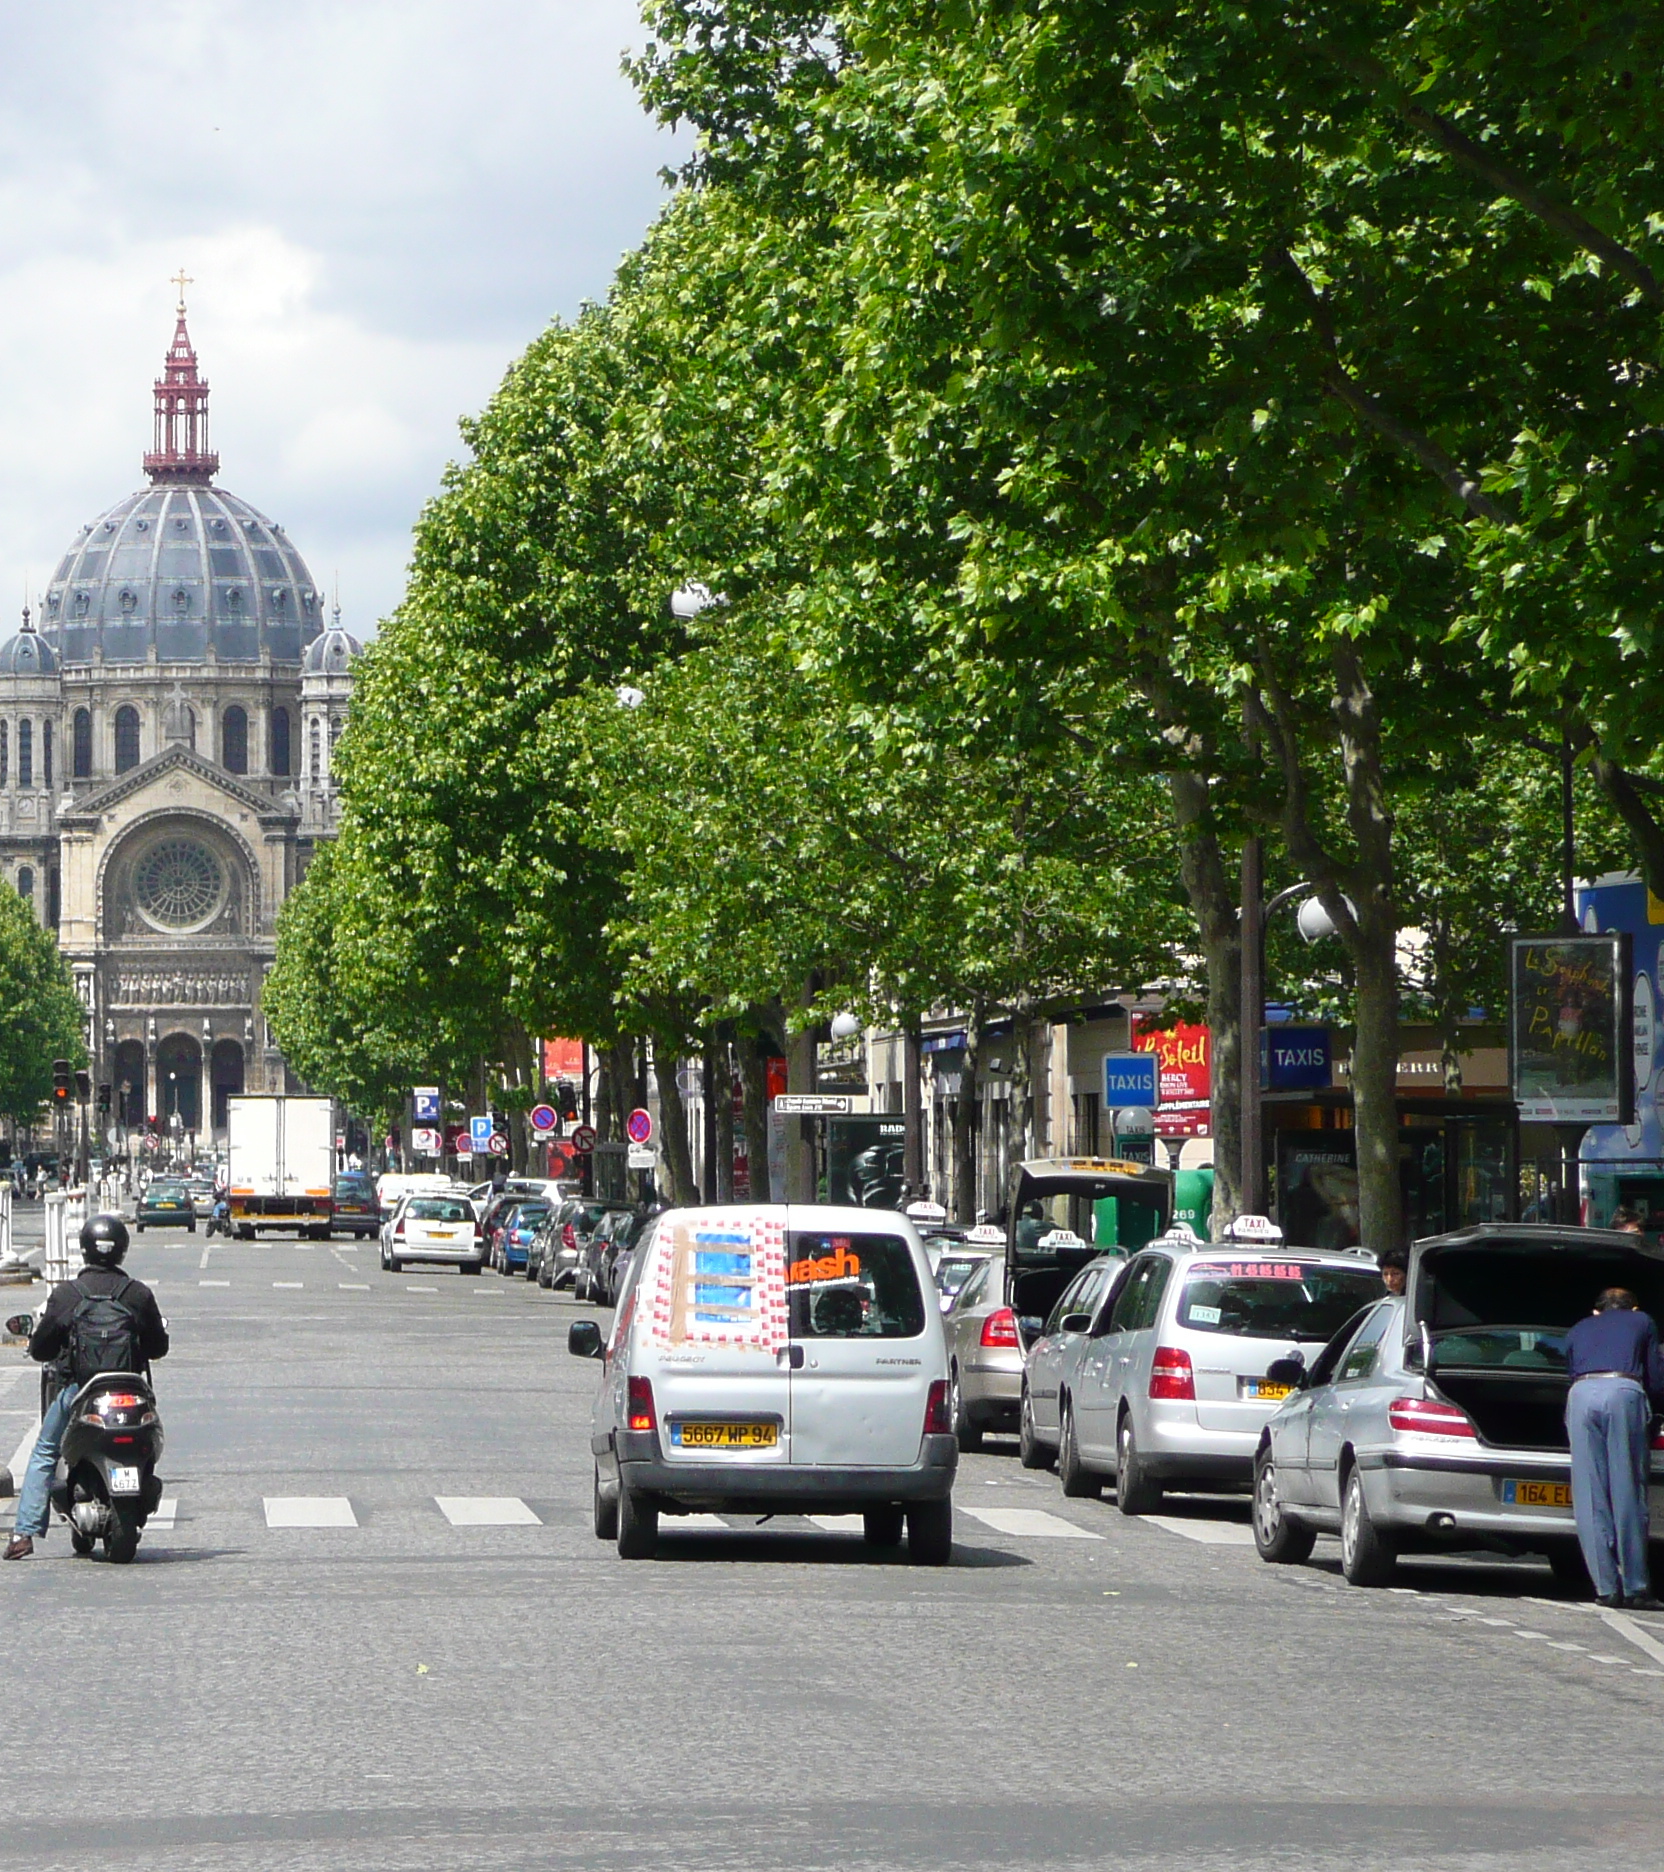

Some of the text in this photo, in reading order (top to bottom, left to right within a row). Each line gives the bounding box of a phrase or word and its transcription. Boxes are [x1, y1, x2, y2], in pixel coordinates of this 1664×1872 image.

[1160, 1035, 1206, 1071] Soleil
[1275, 1048, 1325, 1067] TAXIS
[1108, 1074, 1153, 1091] TAXIS
[1295, 1153, 1351, 1164] CATHERINE
[1172, 1209, 1196, 1220] 269
[1244, 1218, 1266, 1228] TAXI
[978, 1227, 996, 1236] TAXI
[1054, 1232, 1073, 1241] TAXI
[876, 1357, 922, 1366] PARTNER
[683, 1426, 772, 1443] 5667 WP 94
[1520, 1484, 1548, 1502] 164
